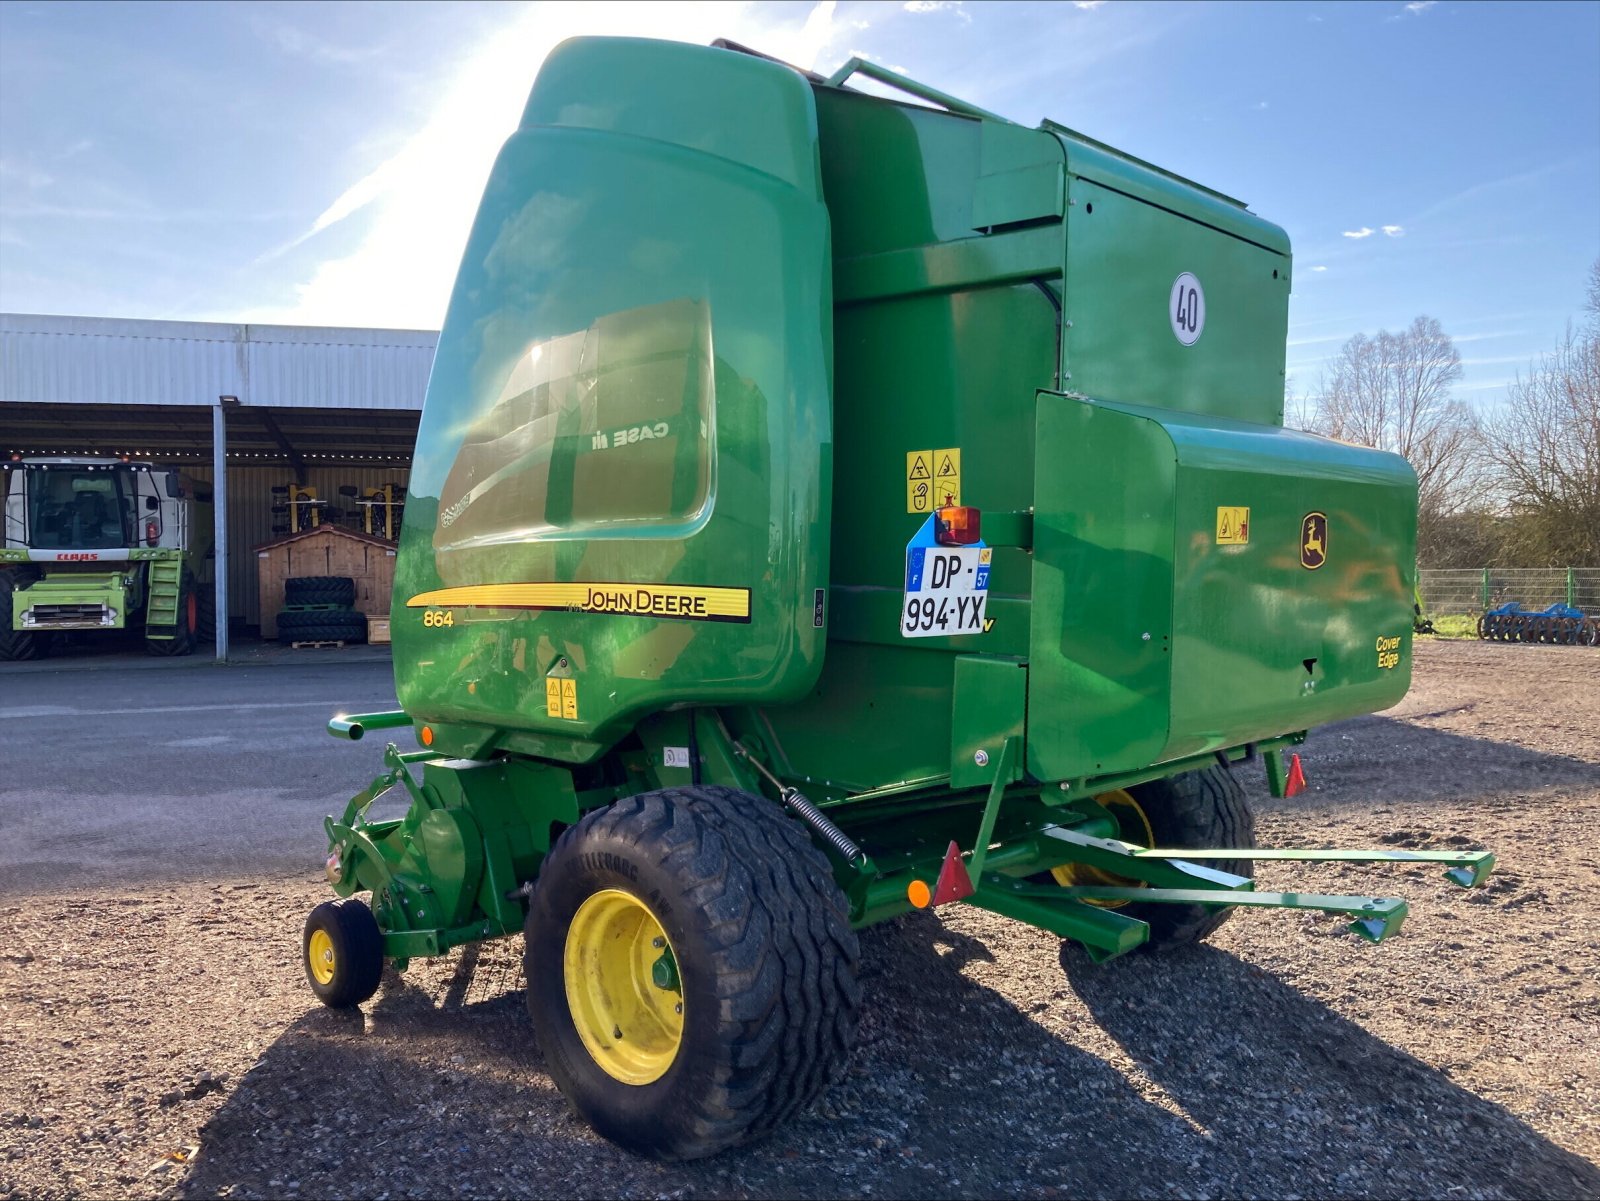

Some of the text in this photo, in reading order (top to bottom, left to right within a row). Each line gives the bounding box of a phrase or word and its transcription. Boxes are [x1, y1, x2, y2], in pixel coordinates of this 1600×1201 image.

[1176, 285, 1197, 333] 40
[56, 553, 98, 561] CLAAS
[913, 574, 919, 585] F
[976, 572, 989, 587] 57
[581, 588, 707, 614] JOHN DEERE
[423, 610, 454, 628] 864
[905, 596, 985, 632] 994-YX
[1376, 636, 1401, 652] Cover
[1377, 651, 1399, 669] Edge
